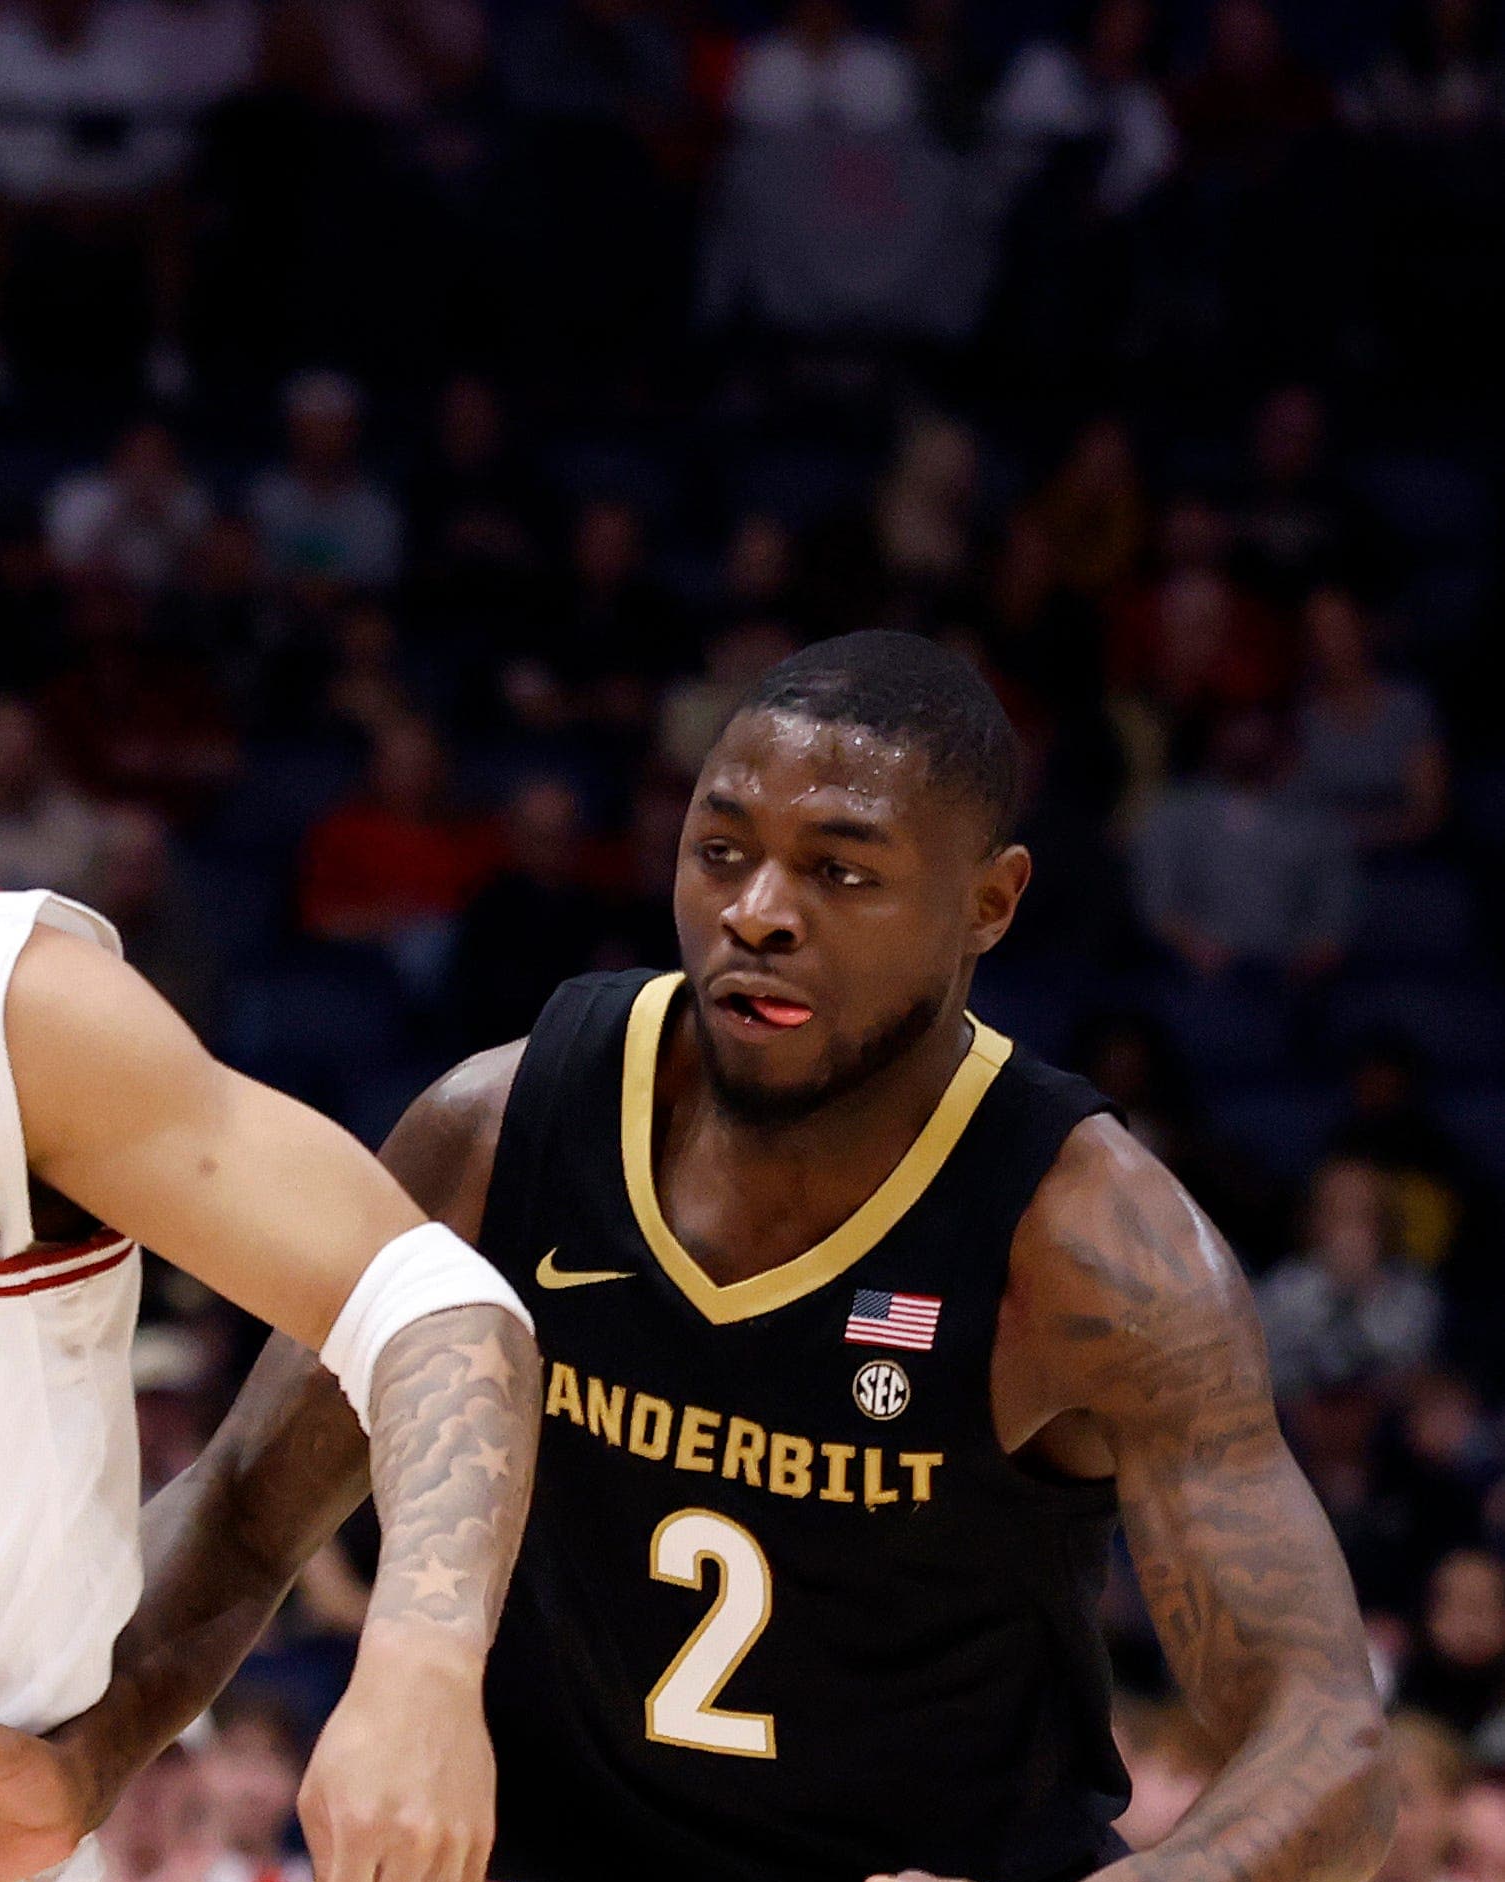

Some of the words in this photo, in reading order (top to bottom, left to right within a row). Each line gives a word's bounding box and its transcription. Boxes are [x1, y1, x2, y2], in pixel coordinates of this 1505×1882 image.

[539, 1356, 944, 1505] ANDERBILT
[858, 1365, 905, 1415] SEC
[645, 1507, 777, 1760] 2
